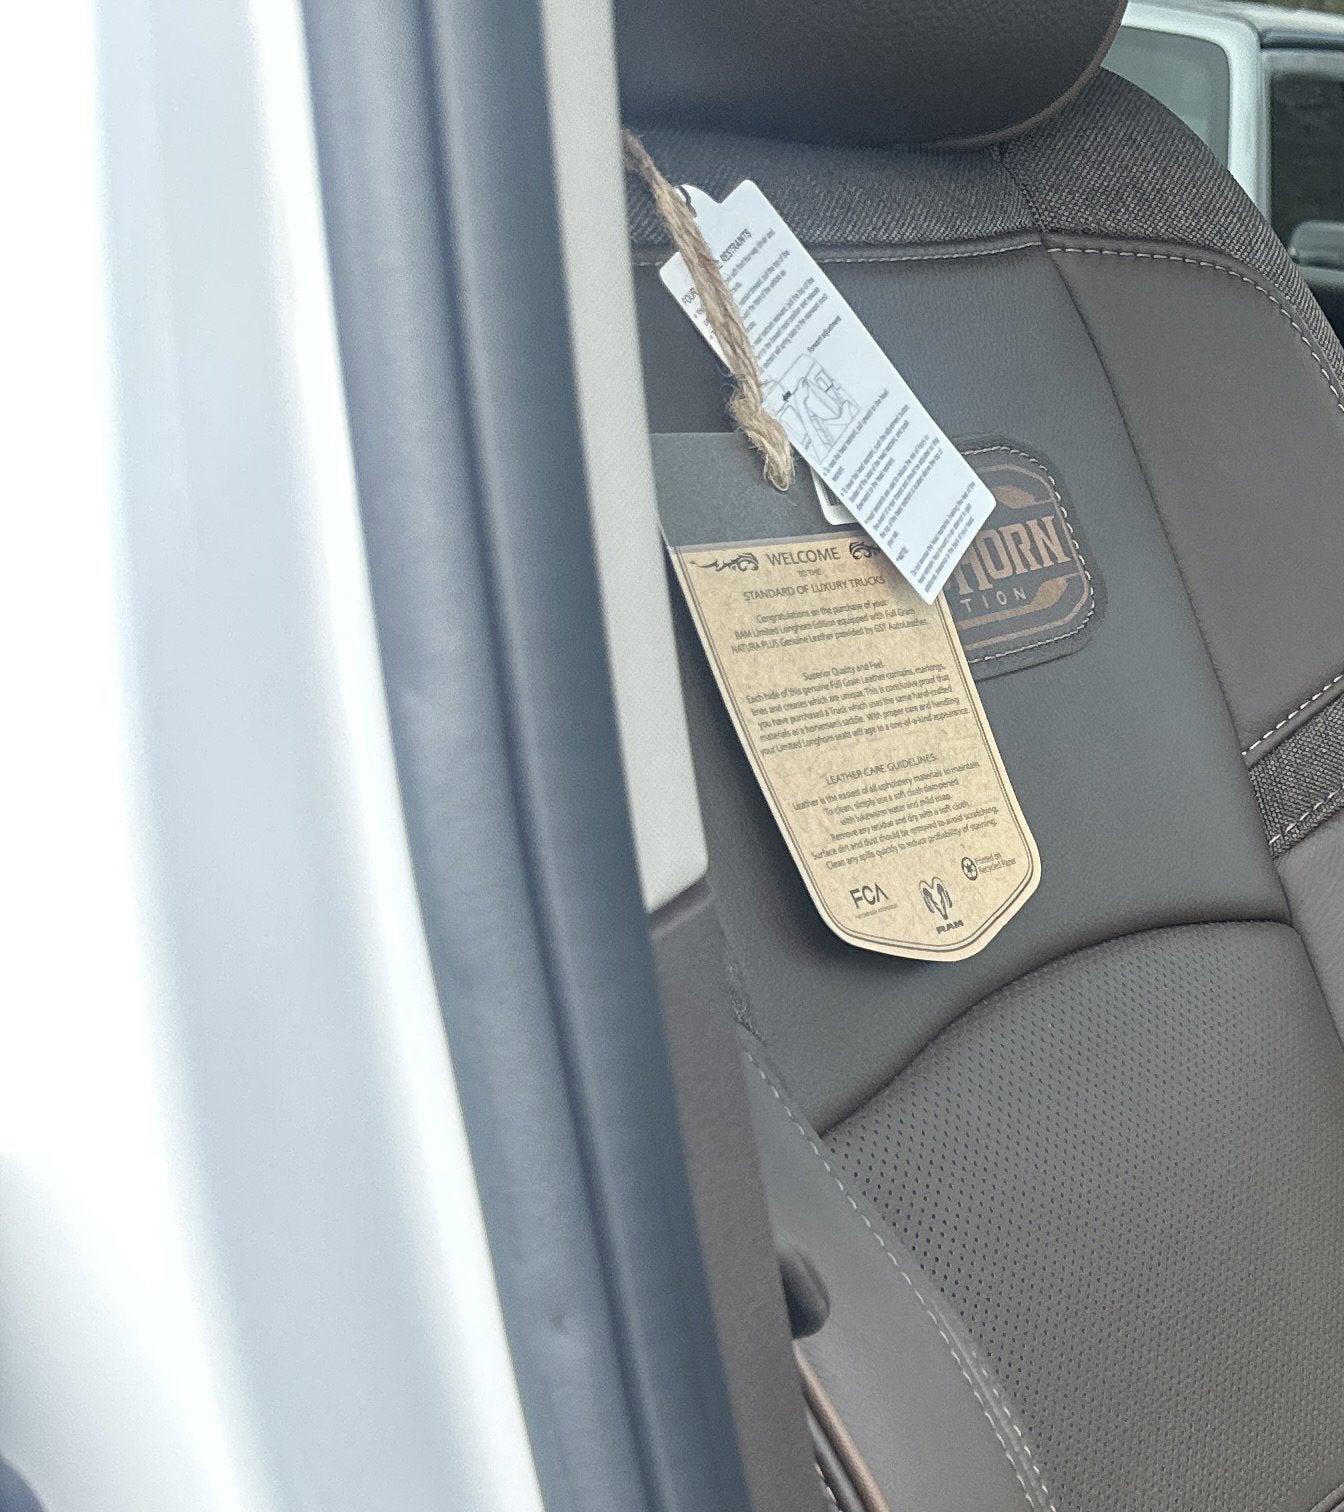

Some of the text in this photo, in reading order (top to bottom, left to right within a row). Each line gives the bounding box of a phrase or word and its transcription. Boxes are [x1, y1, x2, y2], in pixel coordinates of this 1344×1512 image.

[766, 547, 841, 566] WELCOME
[955, 516, 1071, 595] HORN
[744, 576, 886, 601] STANDARD OF LUXURY TRUCKS
[960, 585, 1027, 613] TION
[826, 770, 862, 785] LEATHER
[863, 764, 885, 776] CARE
[850, 881, 889, 909] FCA
[936, 920, 964, 934] RAM
